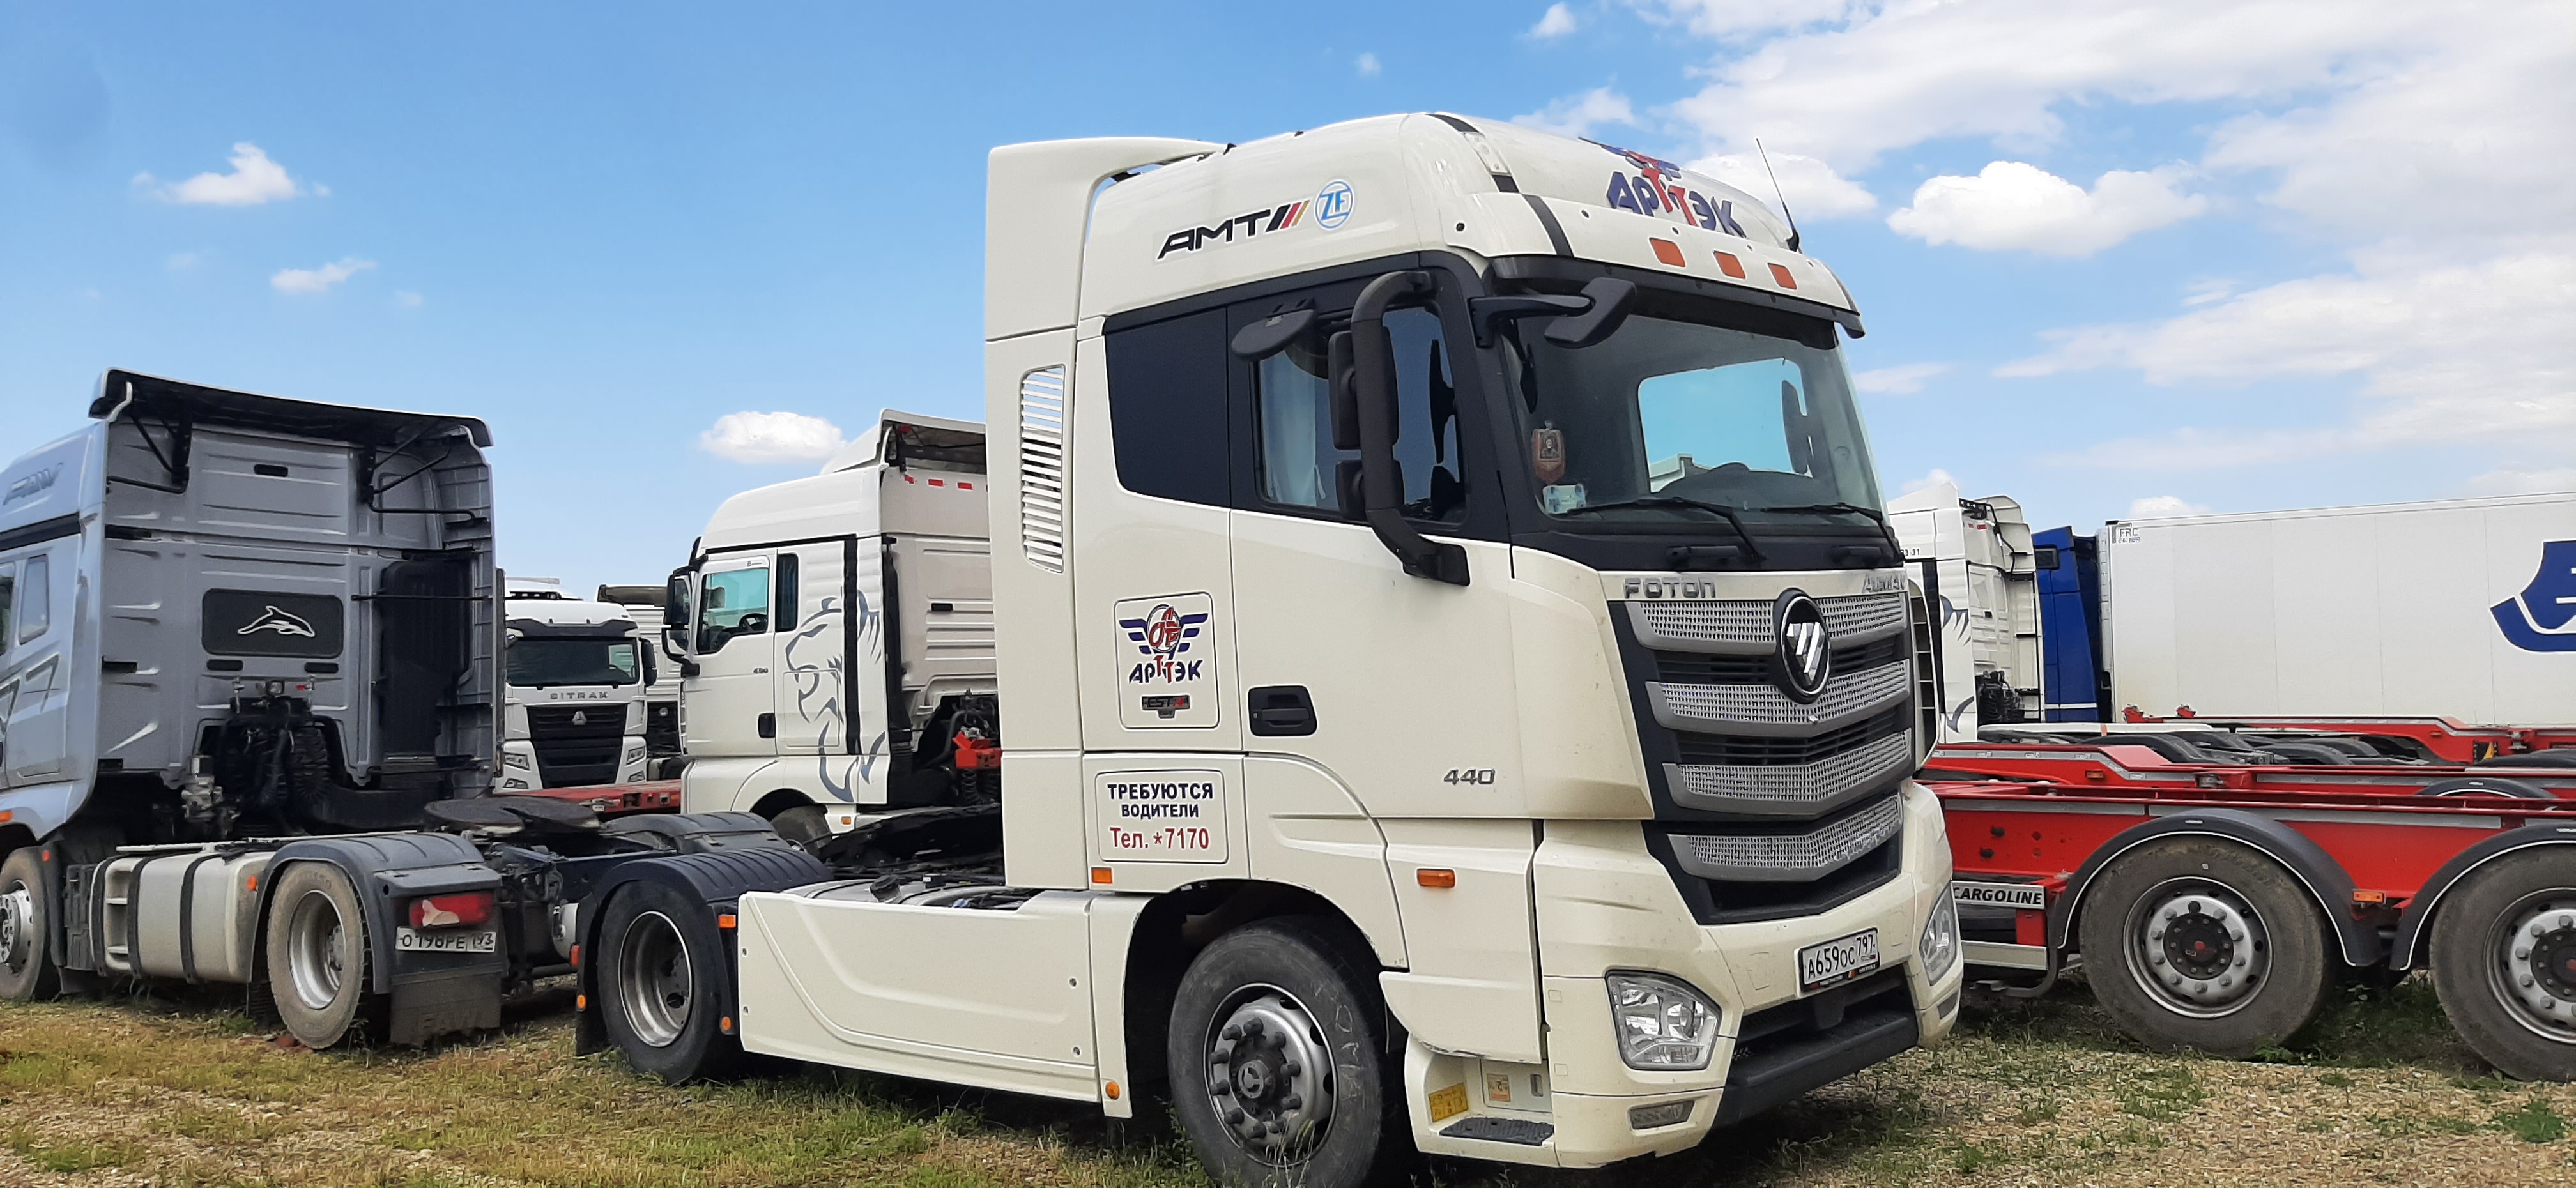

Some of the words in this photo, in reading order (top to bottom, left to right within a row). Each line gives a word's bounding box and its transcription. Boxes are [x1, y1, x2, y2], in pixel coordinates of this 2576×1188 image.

[1317, 186, 1352, 223] ZF
[1157, 209, 1271, 259] AMT
[1625, 577, 1716, 599] FOTON
[550, 692, 608, 700] SITRAK
[1444, 769, 1495, 785] 440
[1107, 783, 1213, 800] ТРЕБУЮТСЯ
[1121, 803, 1199, 819] ВОДИТЕЛИ
[1110, 827, 1149, 849] Тел.
[1952, 887, 2043, 904] CARGOLINE
[1857, 934, 1873, 956] 797
